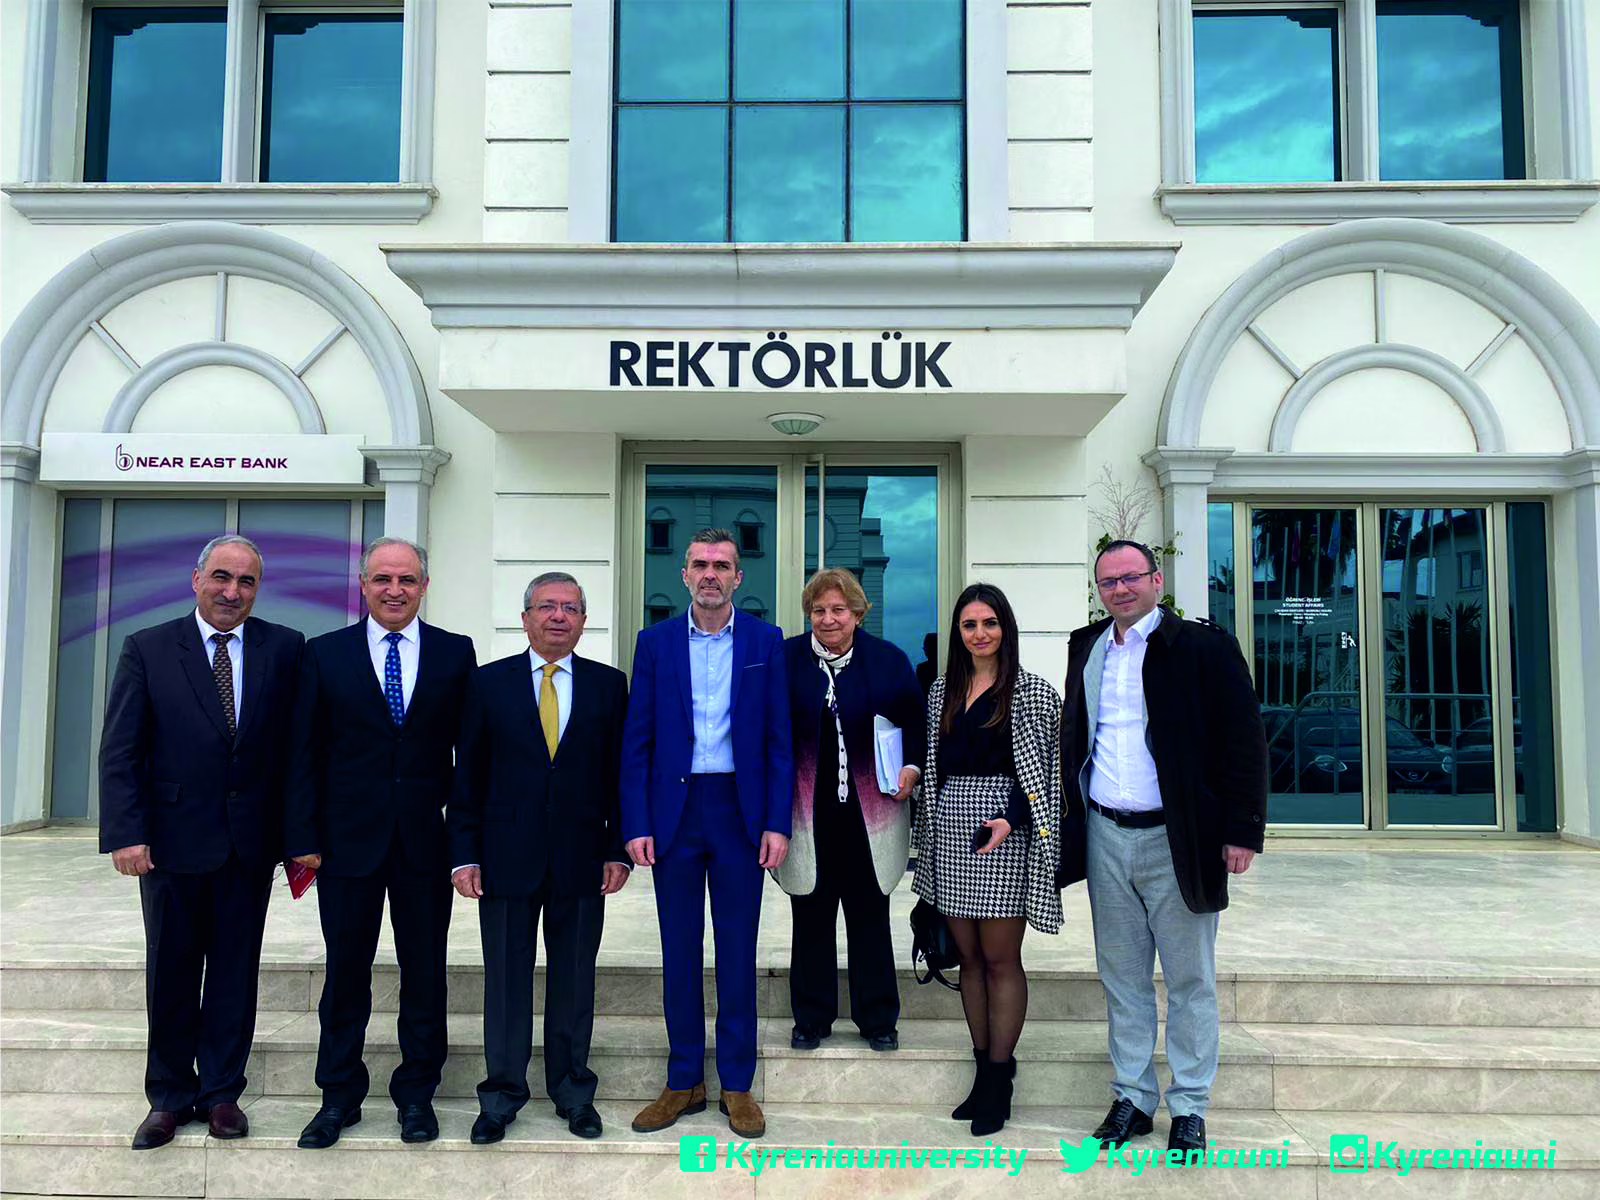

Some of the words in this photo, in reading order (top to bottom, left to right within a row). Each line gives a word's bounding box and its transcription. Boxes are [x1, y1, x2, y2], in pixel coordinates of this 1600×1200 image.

[609, 331, 953, 388] REKTÖRLÜK
[136, 456, 184, 468] NEAR
[190, 457, 236, 468] EAST
[241, 457, 288, 469] BANK
